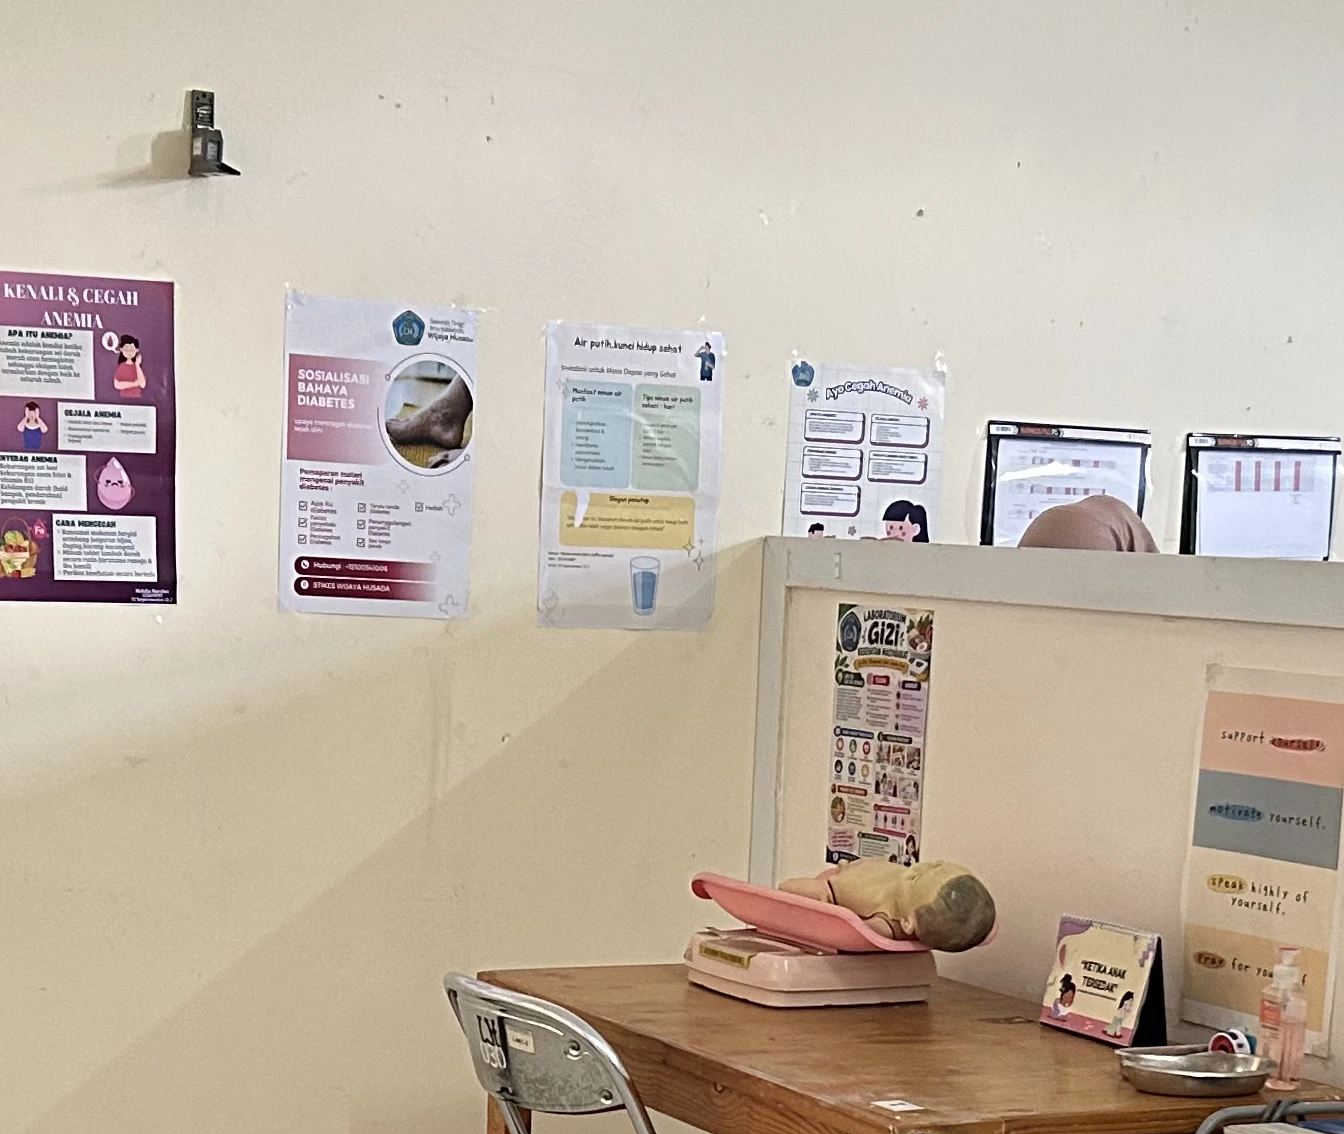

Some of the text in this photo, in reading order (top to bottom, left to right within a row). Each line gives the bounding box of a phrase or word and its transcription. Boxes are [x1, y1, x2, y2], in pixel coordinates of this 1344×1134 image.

[4, 283, 139, 306] KENALI & CEGAH
[41, 311, 104, 329] ANEMIA
[7, 329, 23, 337] APA
[26, 330, 38, 338] ITU
[574, 337, 587, 347] Air
[297, 369, 370, 385] SOSIALISASI
[297, 382, 348, 396] BAHAYA
[825, 379, 913, 405] Ayo Cegah Anemia
[297, 395, 355, 409] DIABETES
[64, 409, 122, 419] GEJALA ANEMIA
[1209, 803, 1263, 821] motivate
[1211, 877, 1309, 902] speak highly of
[1232, 958, 1250, 972] for
